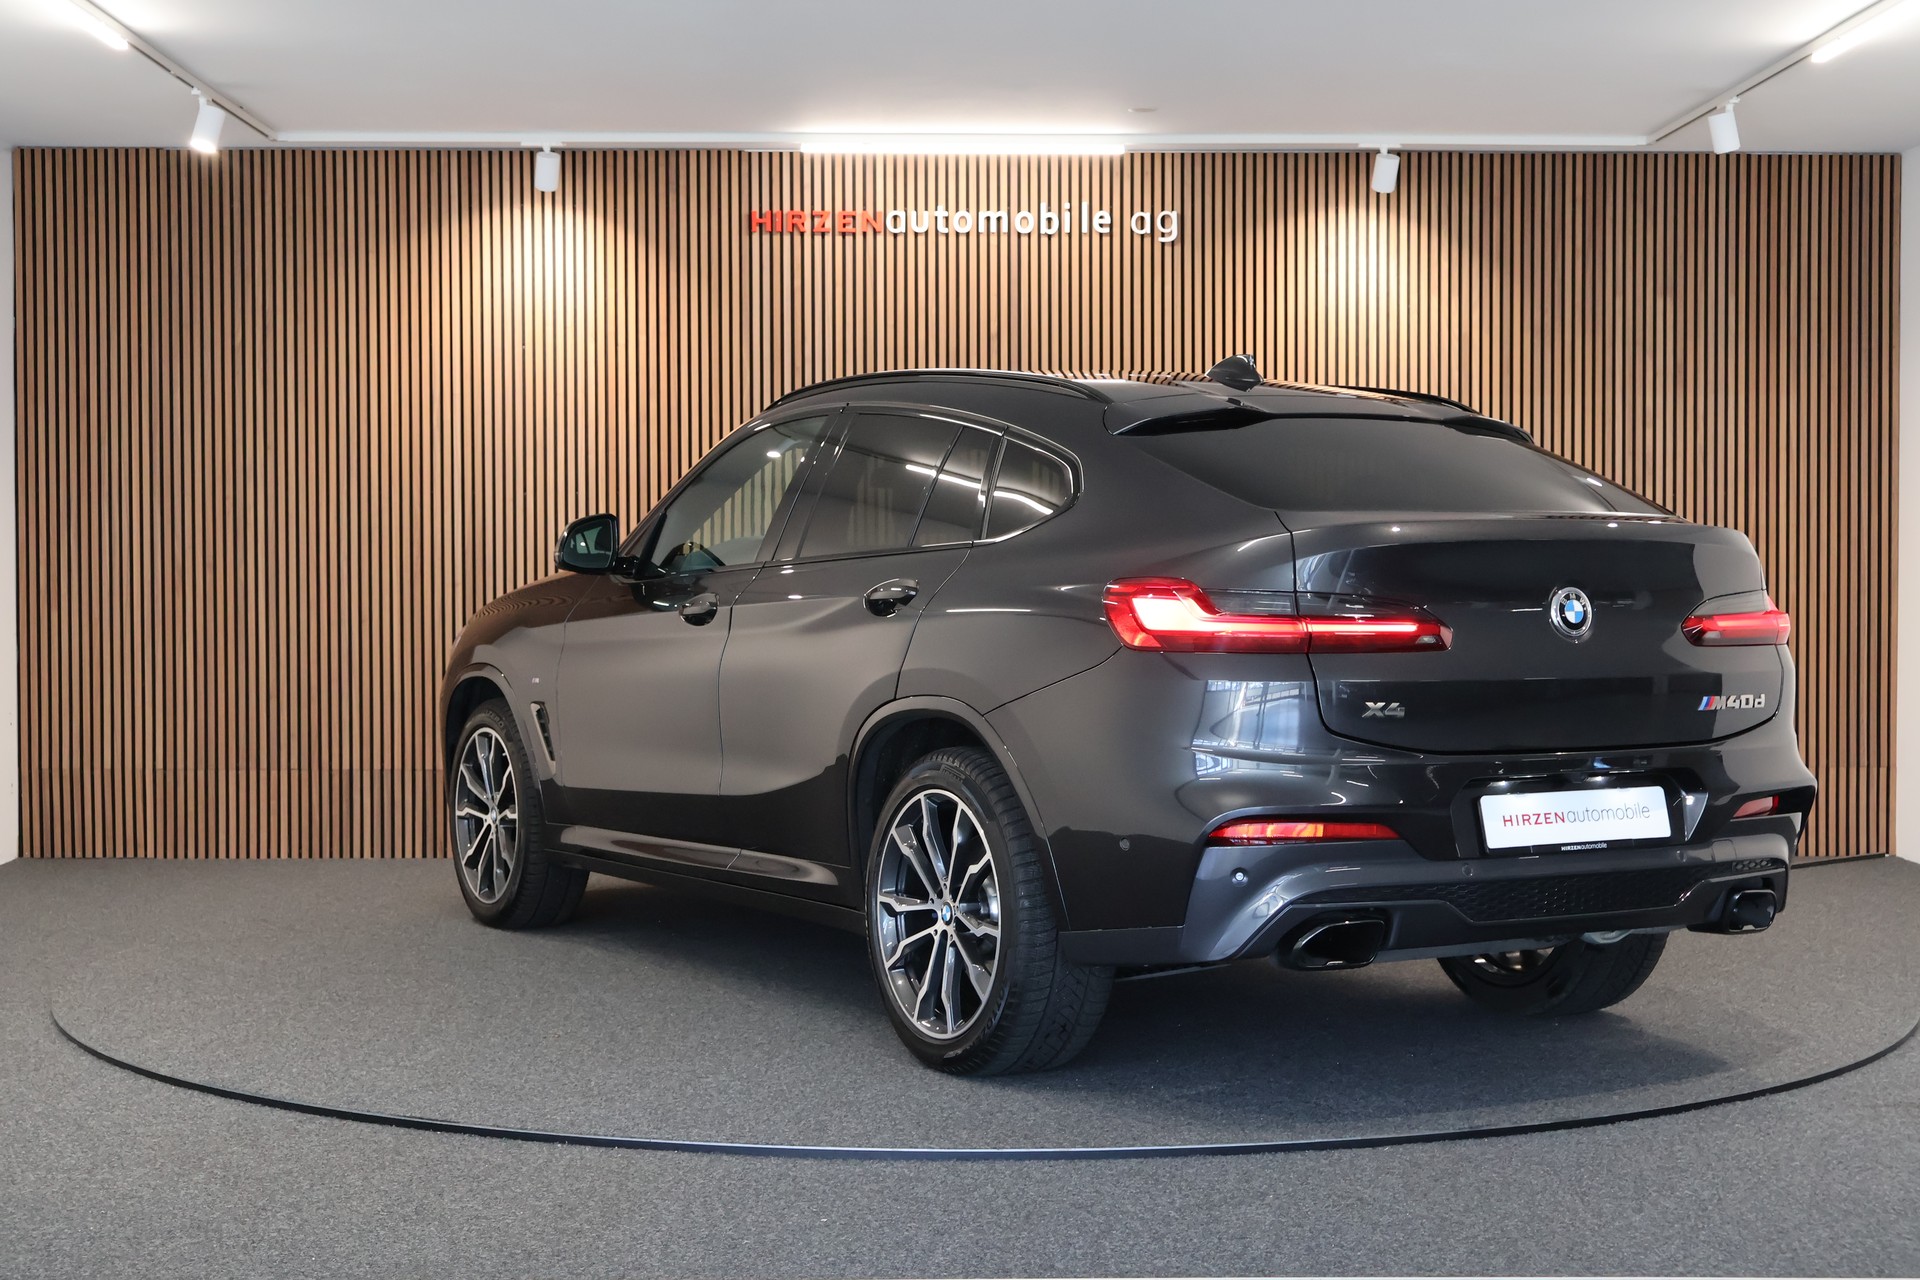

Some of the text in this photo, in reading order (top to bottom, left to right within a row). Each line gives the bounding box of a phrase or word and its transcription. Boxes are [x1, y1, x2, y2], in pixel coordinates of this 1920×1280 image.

[751, 202, 1178, 243] HIRZENautomobile ag
[1362, 702, 1405, 718] X4
[1698, 694, 1765, 711] M40d
[1502, 803, 1650, 827] HIRZENautomobile
